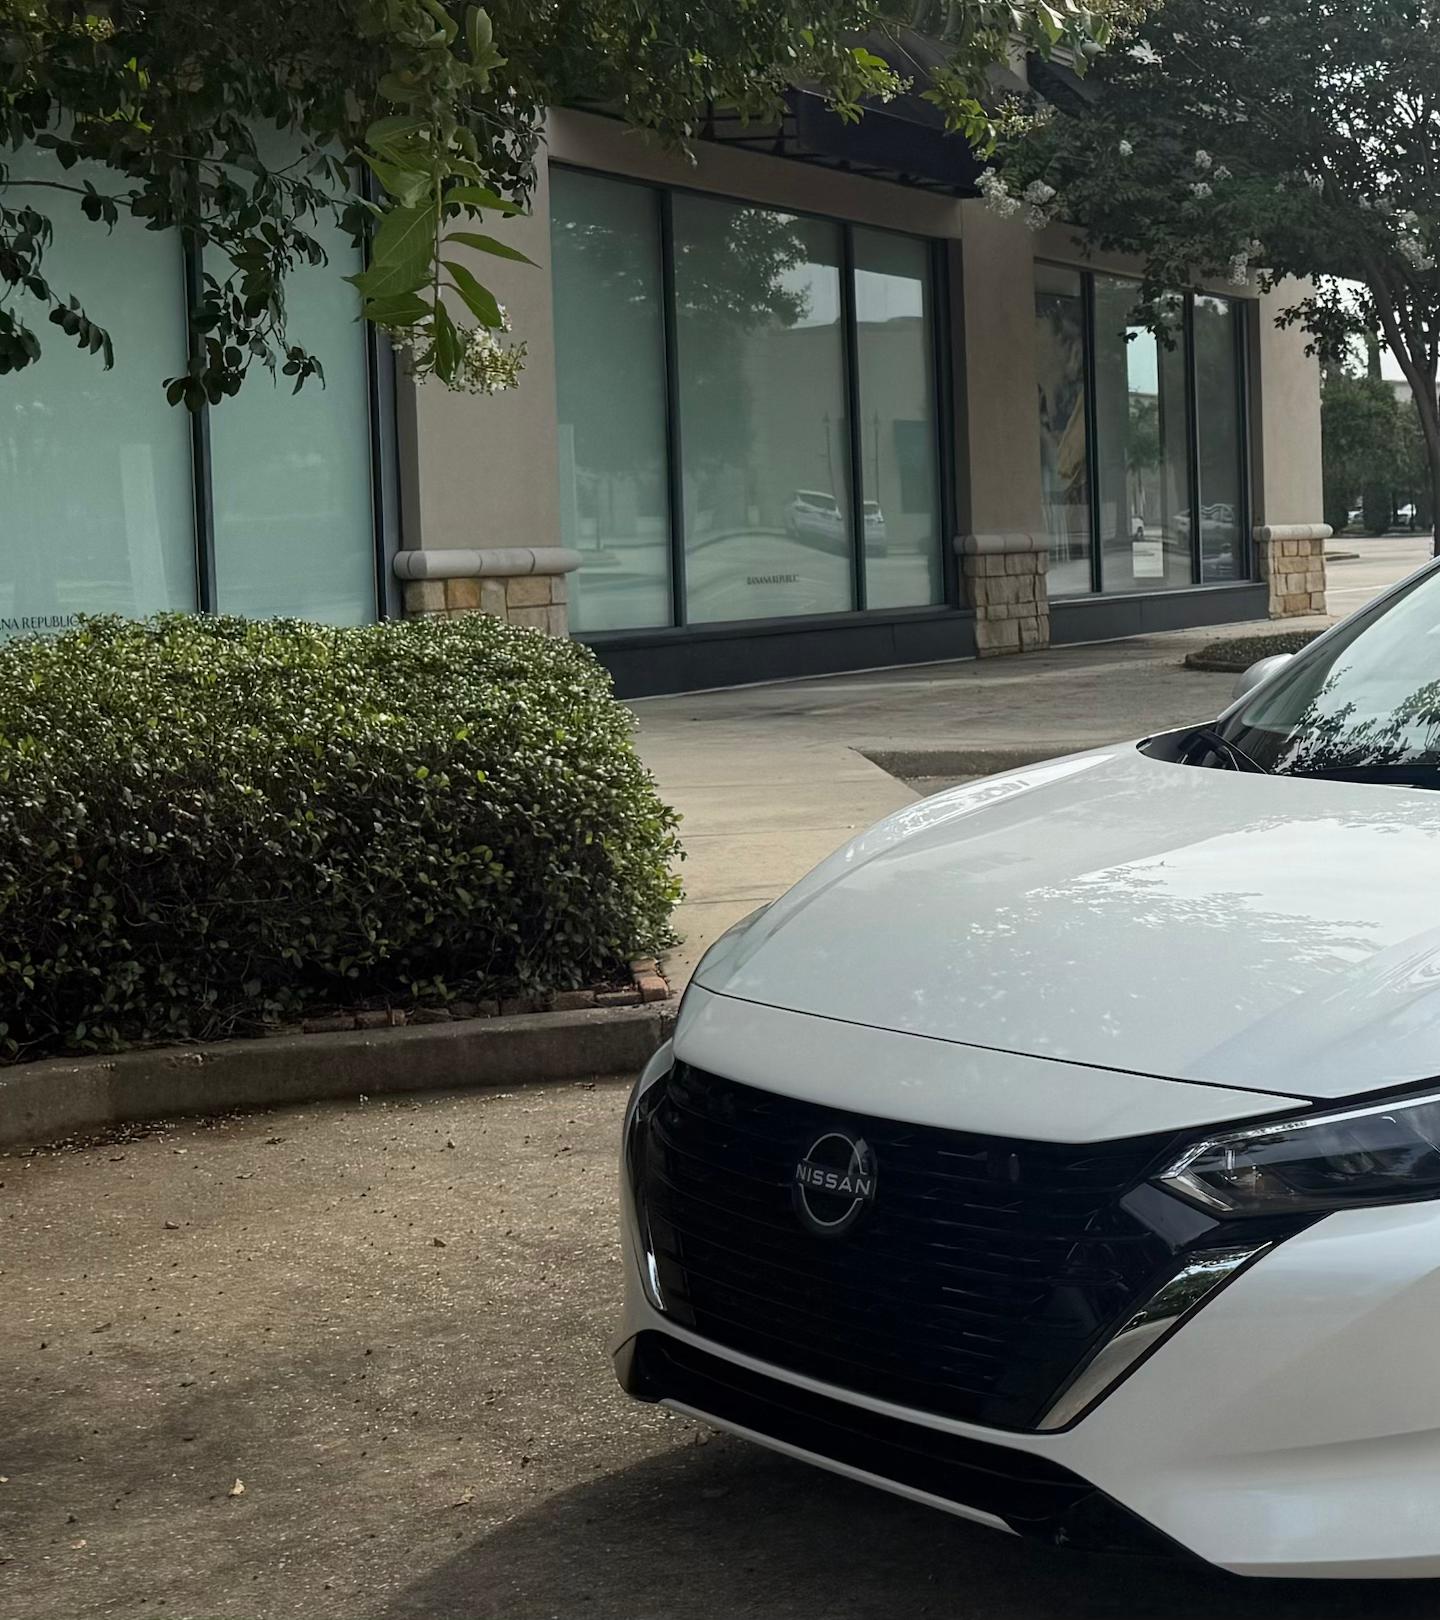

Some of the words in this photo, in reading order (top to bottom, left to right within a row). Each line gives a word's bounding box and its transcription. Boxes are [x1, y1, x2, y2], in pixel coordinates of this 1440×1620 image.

[0, 618, 19, 630] NA
[22, 615, 80, 629] REPUBLIC
[796, 1163, 871, 1195] NISSAN
